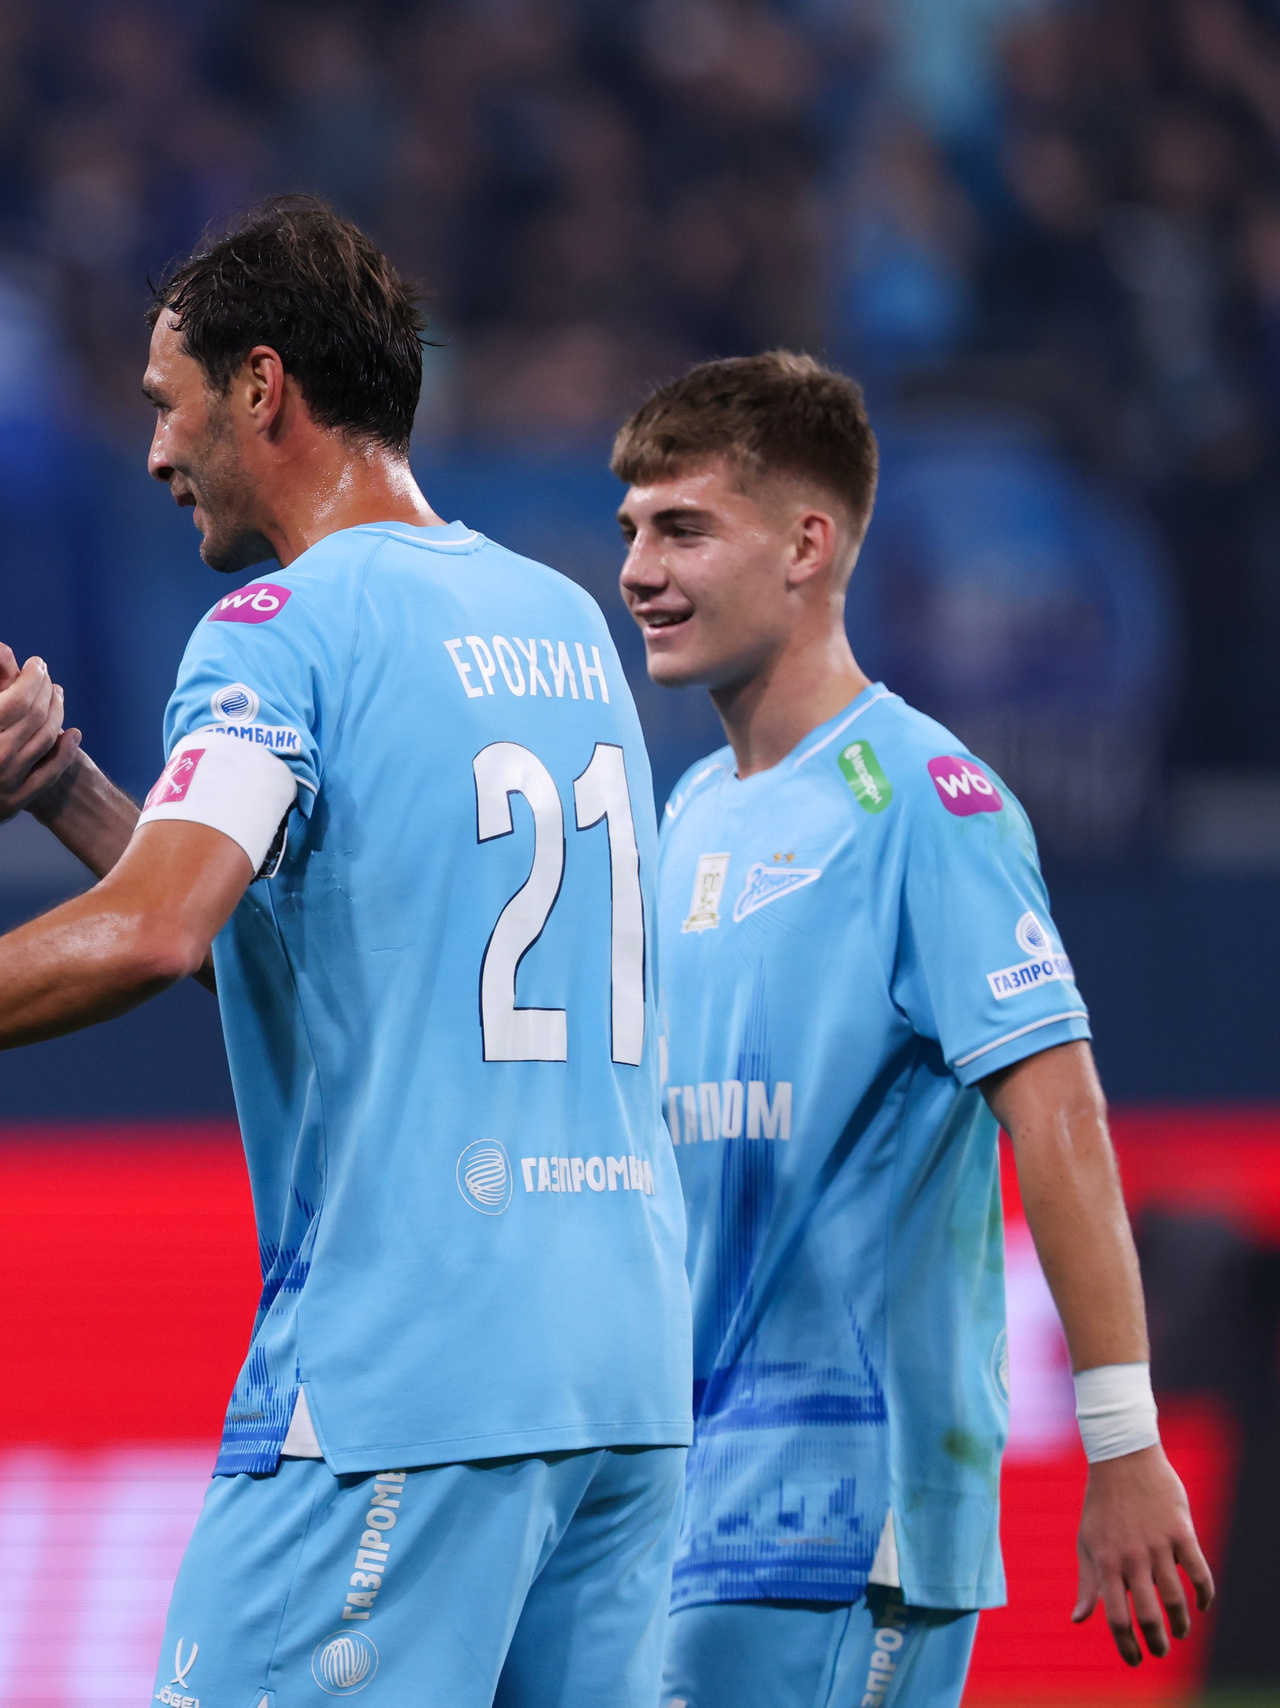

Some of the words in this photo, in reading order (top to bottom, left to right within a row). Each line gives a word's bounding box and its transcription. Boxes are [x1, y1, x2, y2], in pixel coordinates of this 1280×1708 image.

[220, 588, 280, 612] wb
[442, 635, 610, 705] ЕРОХИН
[935, 765, 994, 799] wb
[471, 740, 647, 1068] 21
